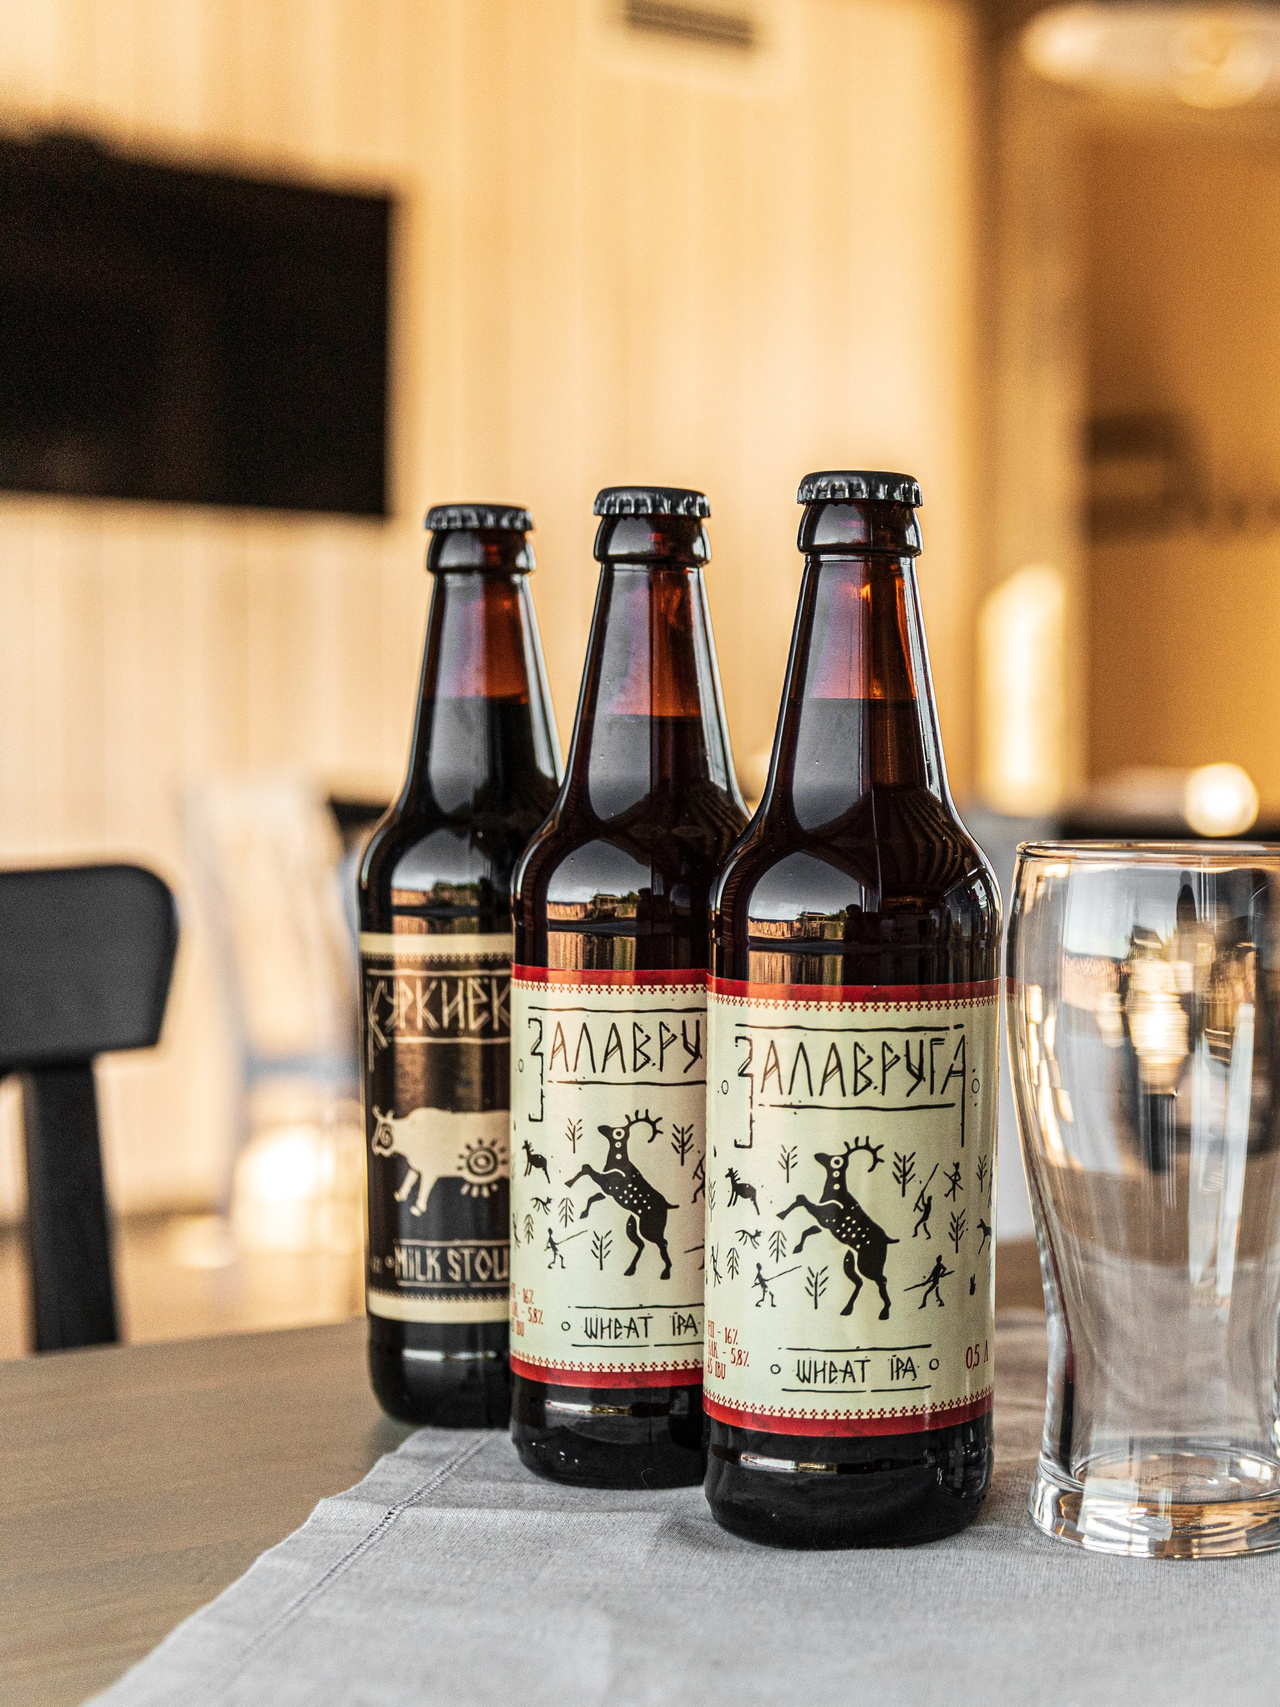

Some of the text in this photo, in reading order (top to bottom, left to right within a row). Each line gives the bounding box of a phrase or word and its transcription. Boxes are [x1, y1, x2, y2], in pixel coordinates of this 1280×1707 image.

[734, 1034, 966, 1148] ЗАЛАВРУГА
[584, 1311, 700, 1340] WHEAT IPA
[724, 1326, 739, 1345] 16%
[794, 1354, 918, 1384] WHEAT IPA
[965, 1346, 980, 1370] 0,5
